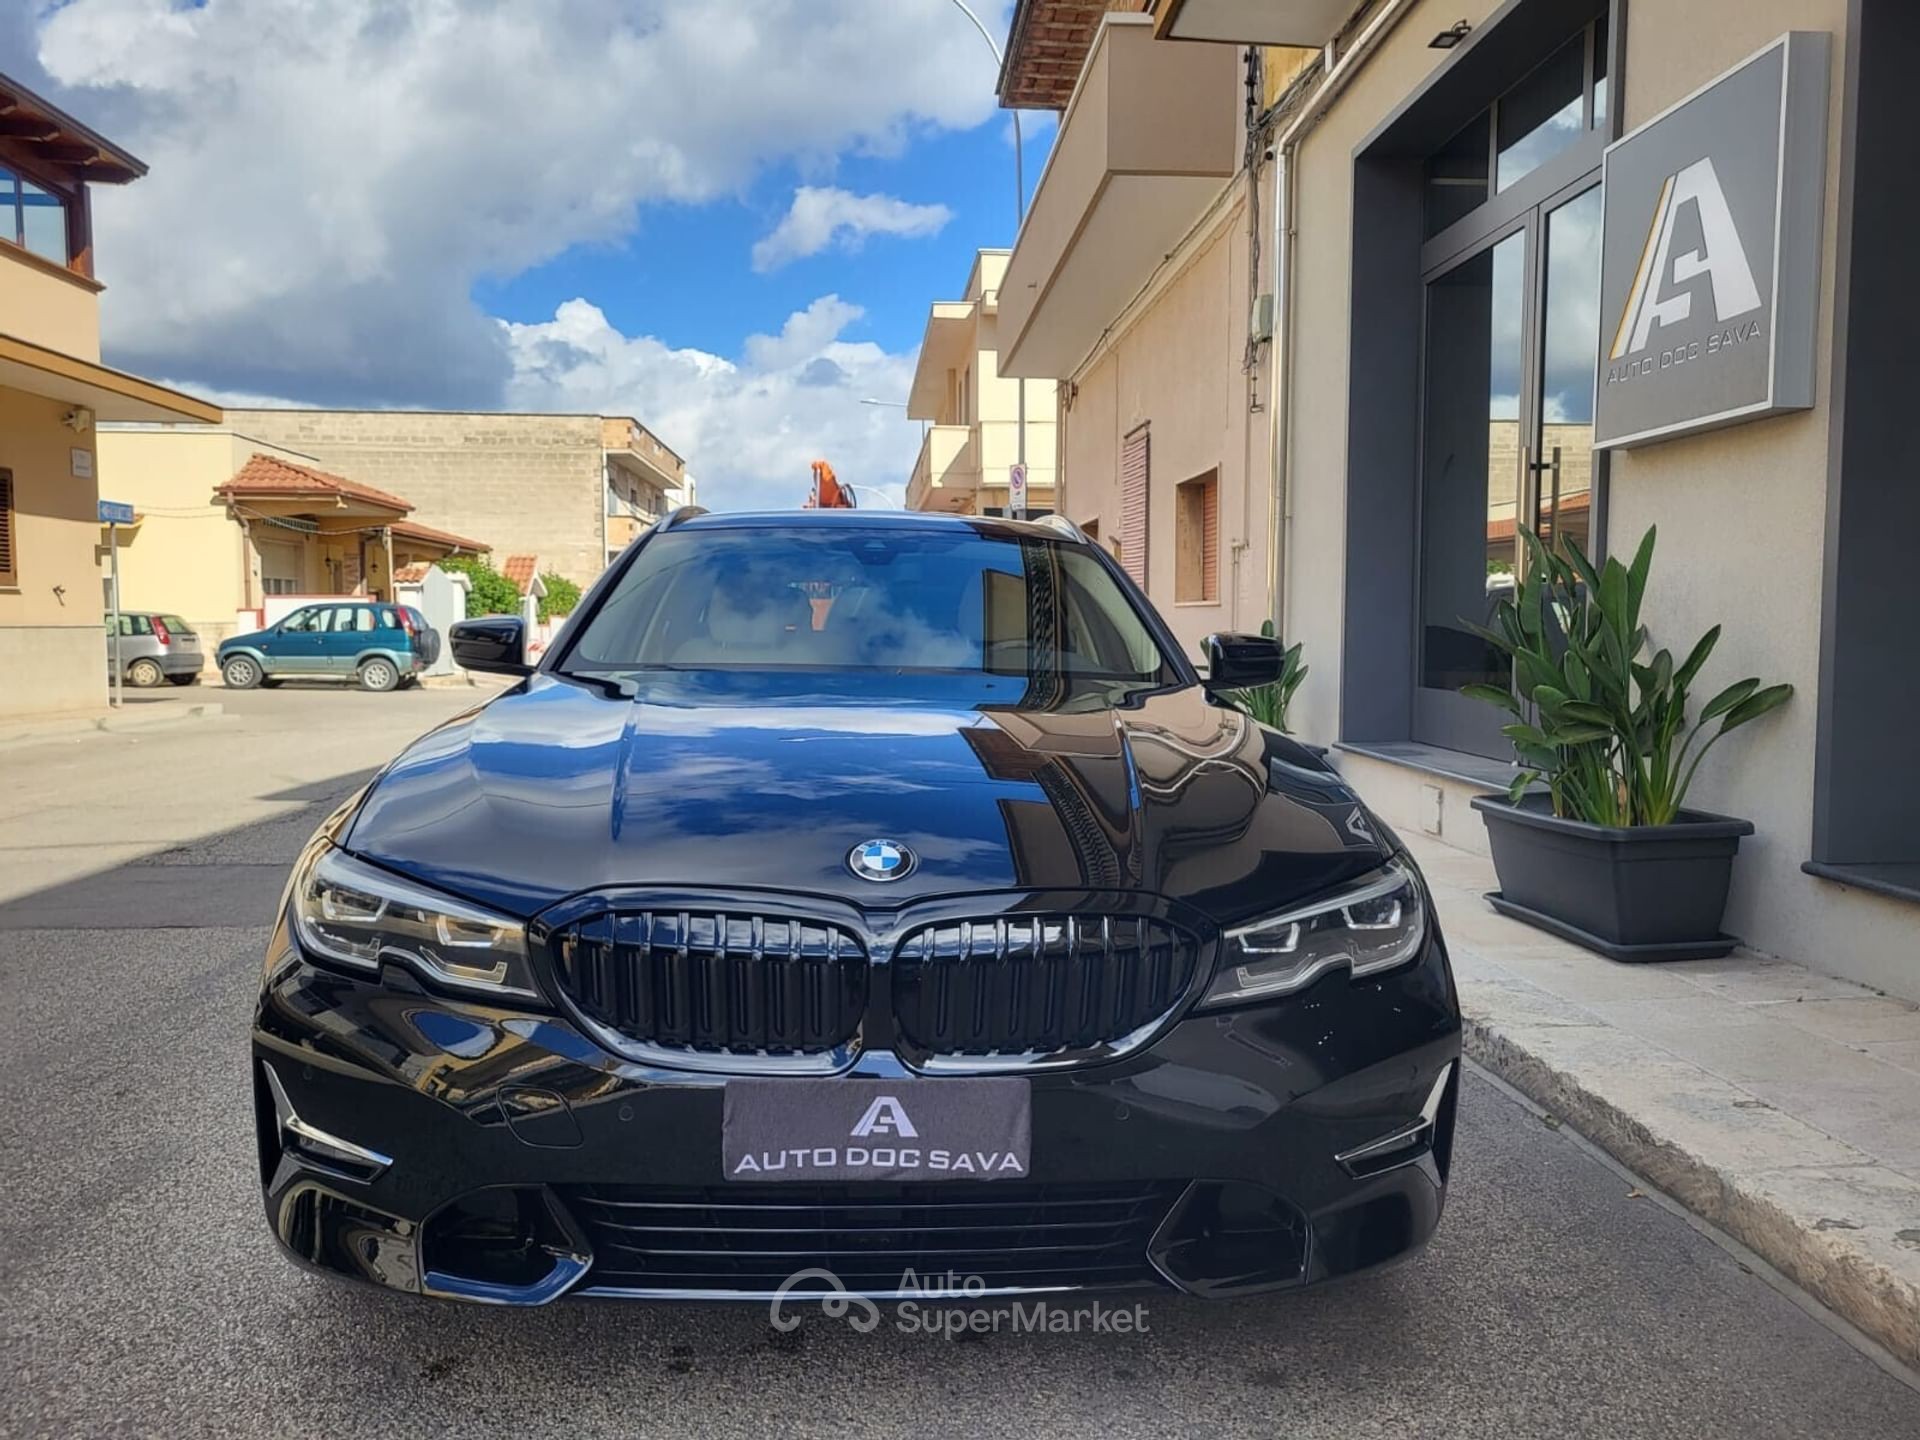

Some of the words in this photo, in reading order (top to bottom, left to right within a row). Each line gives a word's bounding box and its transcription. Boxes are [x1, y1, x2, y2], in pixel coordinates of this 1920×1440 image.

[1607, 358, 1652, 385] AUTO
[1659, 342, 1698, 368] DOC
[1706, 320, 1760, 353] SAVA
[733, 1148, 837, 1174] AUTO
[846, 1147, 921, 1168] DOC
[927, 1149, 1024, 1173] SAVA
